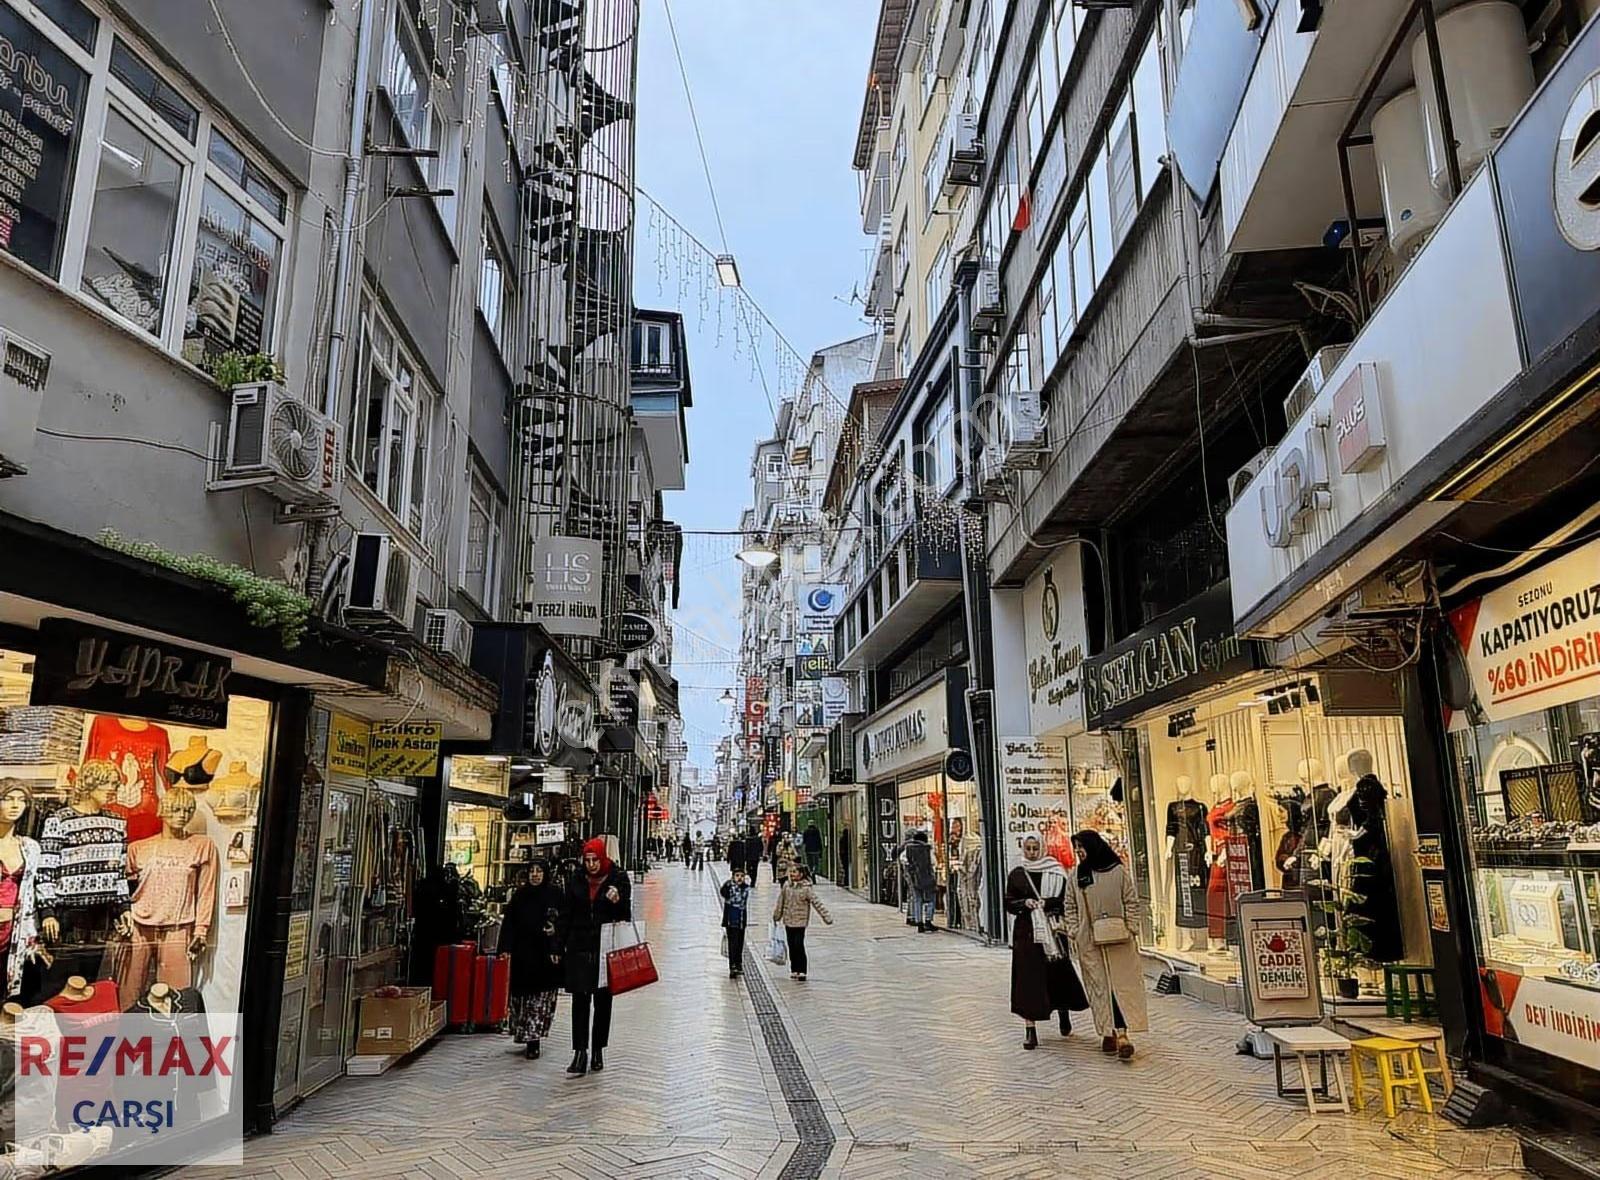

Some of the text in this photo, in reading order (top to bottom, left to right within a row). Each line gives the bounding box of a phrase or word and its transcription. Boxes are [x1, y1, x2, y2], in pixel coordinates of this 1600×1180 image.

[1335, 397, 1366, 442] PLUS
[322, 427, 335, 489] VESTEL
[545, 552, 592, 585] HS
[1517, 581, 1553, 608] SEZONU
[536, 601, 598, 619] TERZİ HÜLYA
[1487, 657, 1527, 696] %60
[402, 738, 438, 750] Astar
[1258, 953, 1302, 967] CADDE
[1525, 1003, 1547, 1028] DEV
